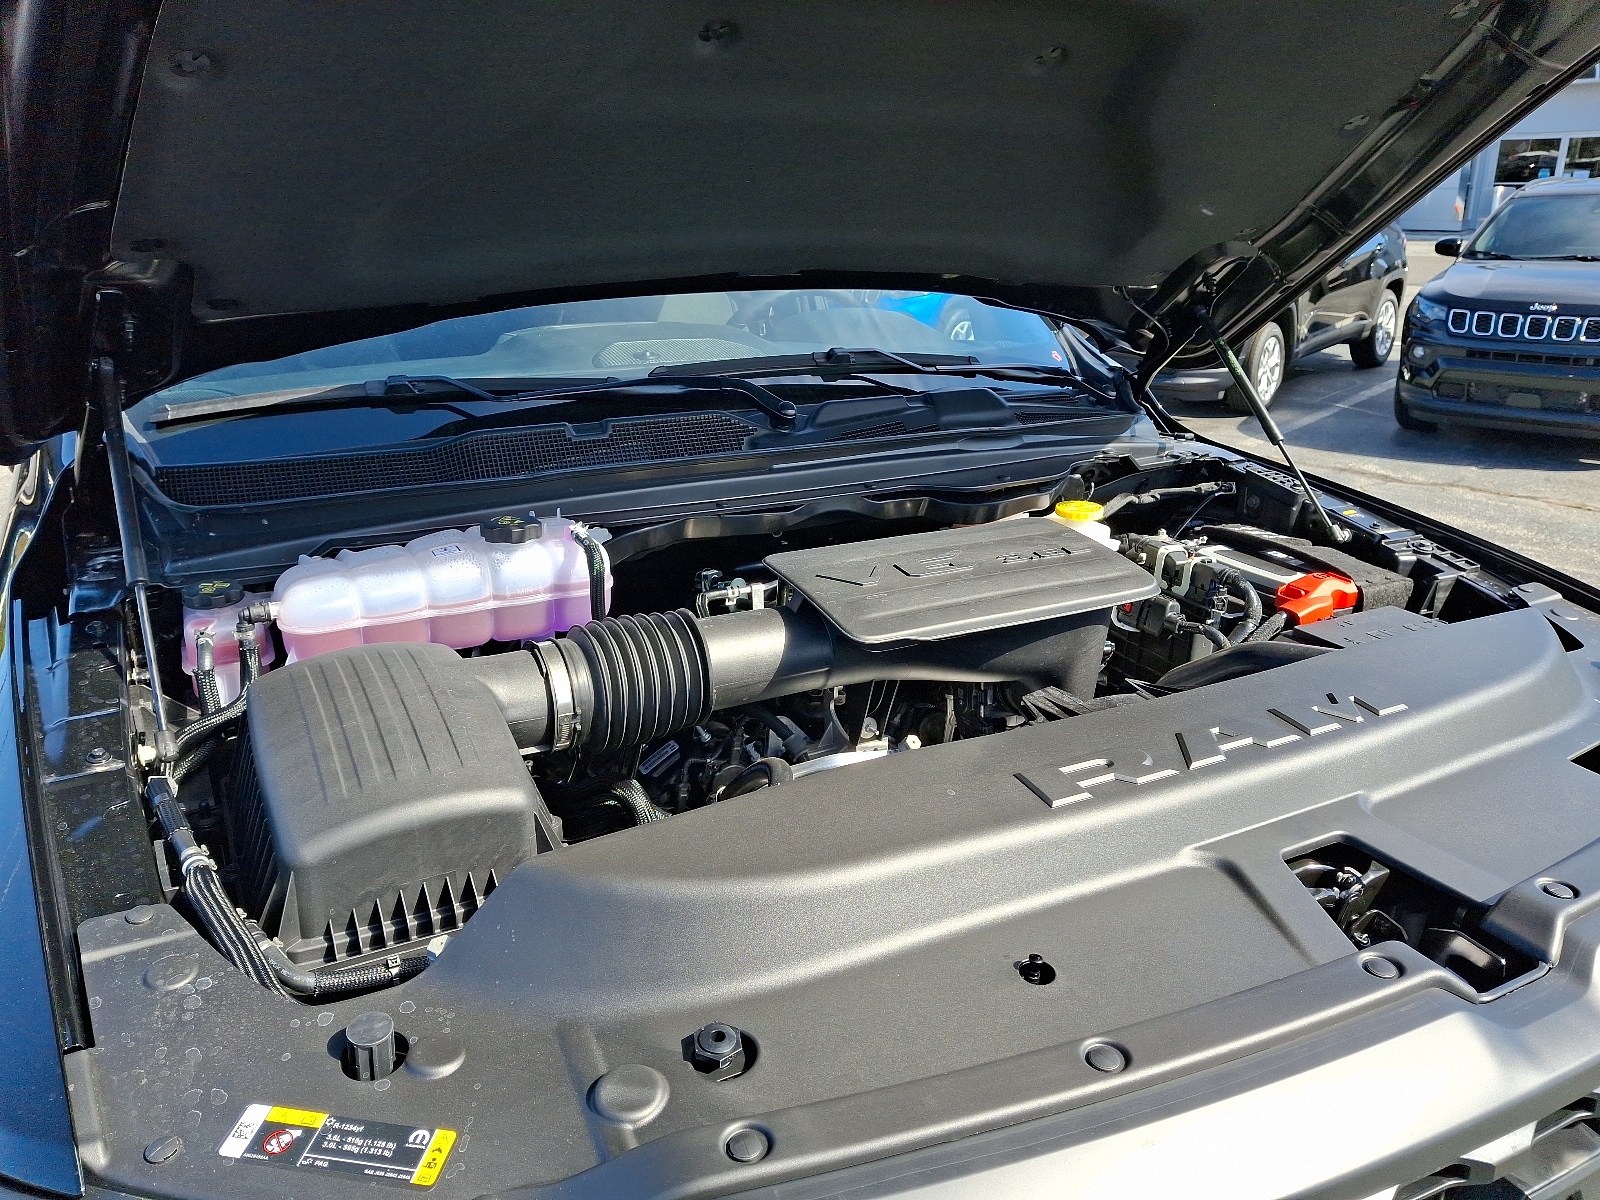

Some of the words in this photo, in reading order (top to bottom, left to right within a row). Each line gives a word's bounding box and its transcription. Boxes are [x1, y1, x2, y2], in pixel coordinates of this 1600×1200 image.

[1529, 302, 1557, 312] Jeep
[1012, 691, 1409, 808] RAM
[333, 1122, 365, 1133] R-1234yf
[322, 1141, 337, 1149] 3.0L
[382, 1149, 393, 1158] lb)
[326, 1134, 341, 1142] 3.6L
[386, 1142, 397, 1150] lb)
